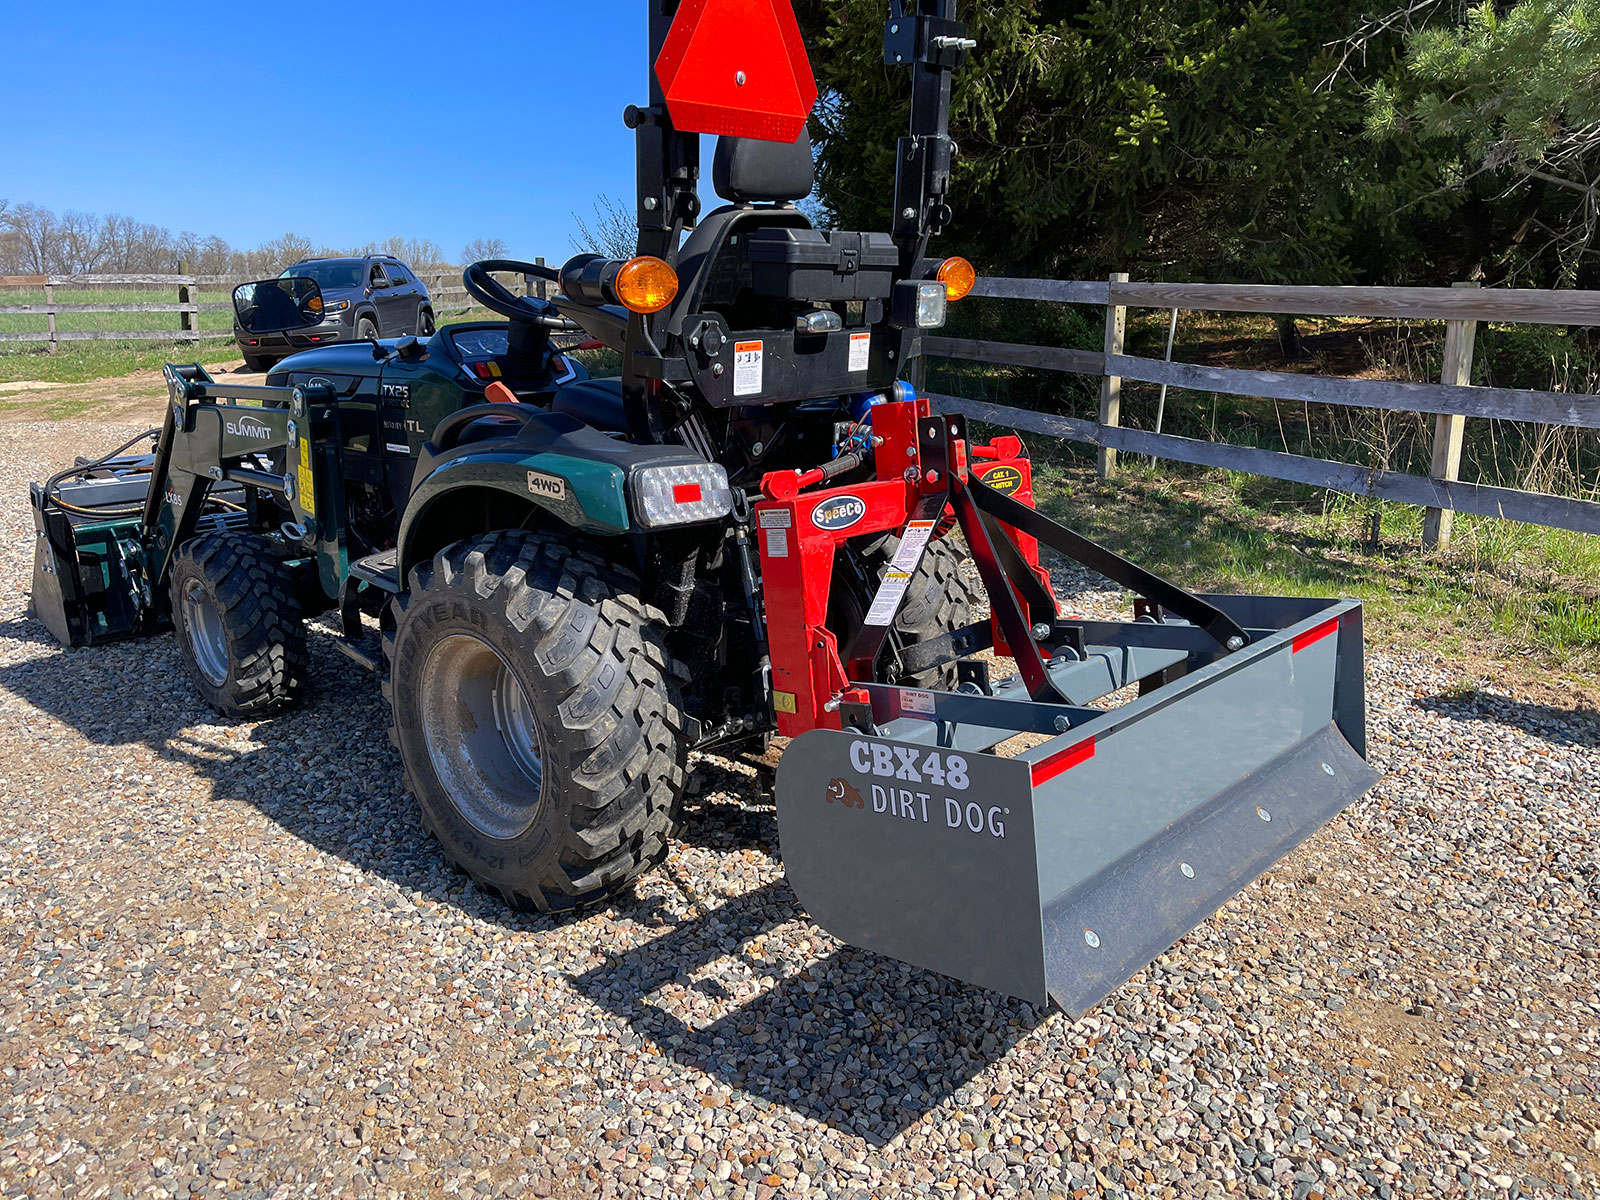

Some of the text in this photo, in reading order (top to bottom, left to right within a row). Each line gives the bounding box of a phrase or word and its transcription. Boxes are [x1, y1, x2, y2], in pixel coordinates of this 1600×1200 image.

[383, 384, 409, 398] TX25
[226, 419, 272, 440] SUMMIT
[532, 477, 561, 495] 4WD
[397, 602, 488, 730] GOODYEAR
[849, 739, 970, 791] CBX48
[871, 784, 1006, 839] DIRT DOG
